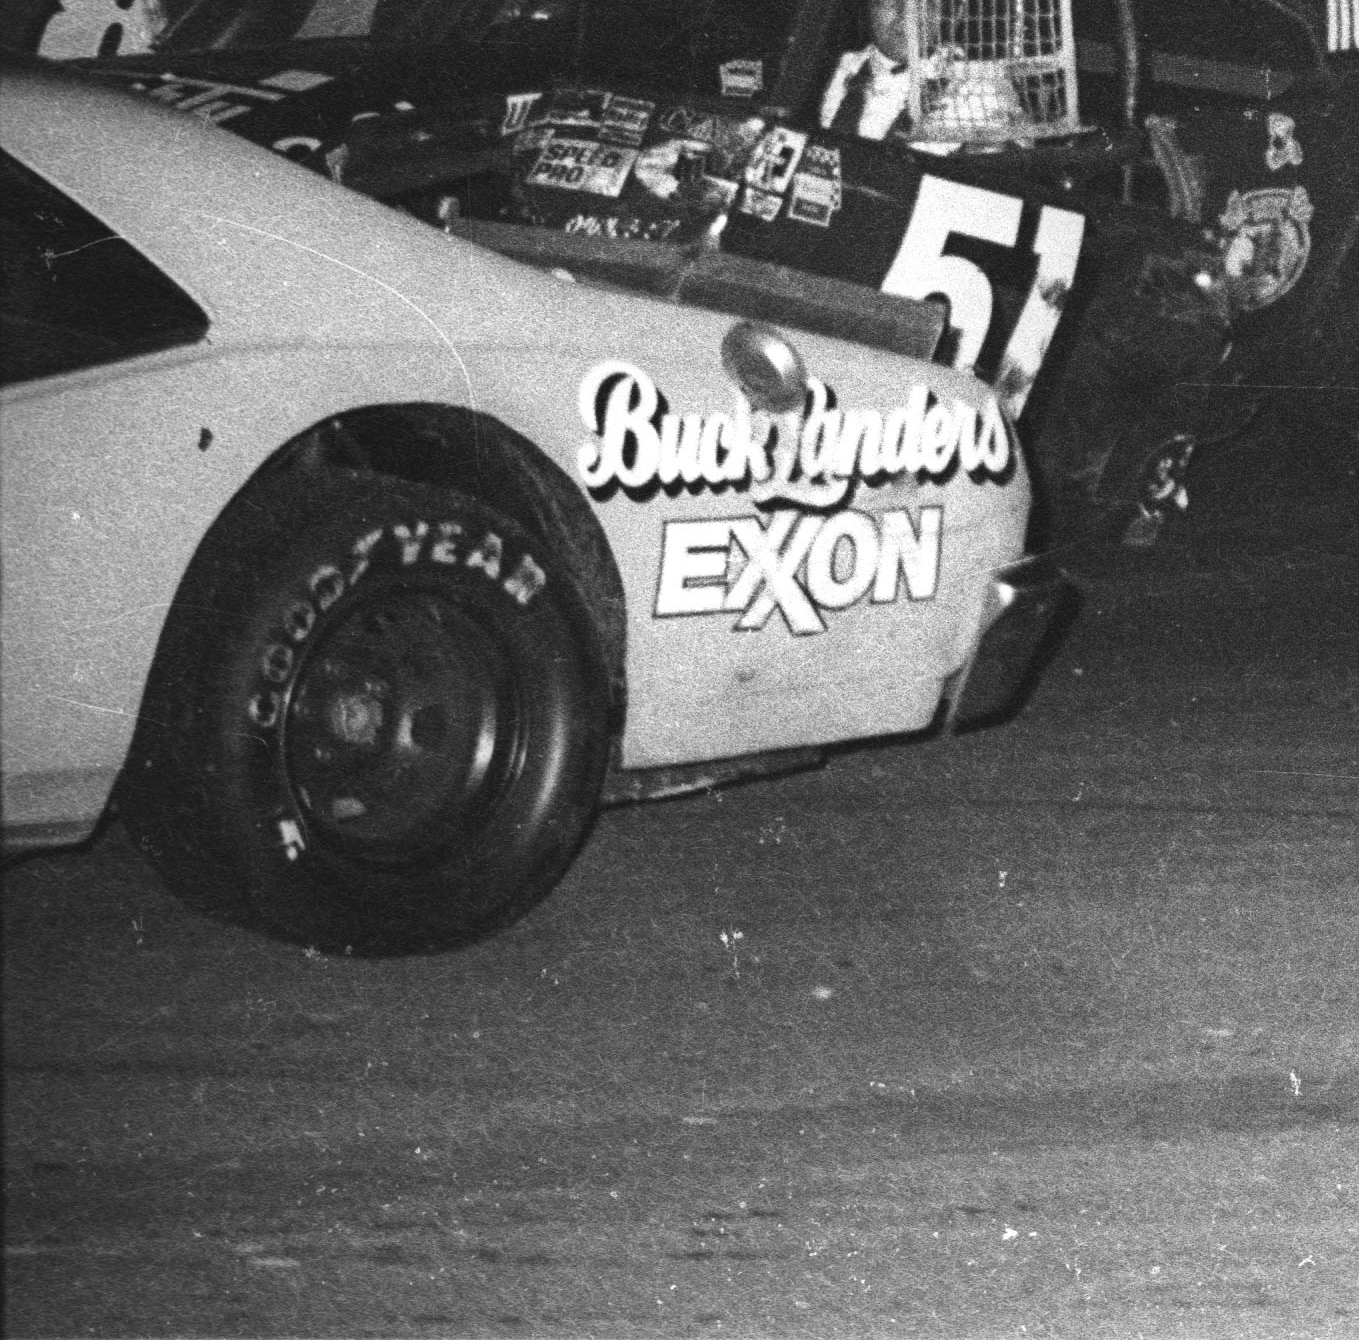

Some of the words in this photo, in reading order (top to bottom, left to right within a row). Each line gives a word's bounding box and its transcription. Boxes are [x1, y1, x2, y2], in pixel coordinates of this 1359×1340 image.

[532, 160, 586, 184] PRO
[543, 141, 622, 170] SPEED
[880, 173, 1085, 421] 51
[576, 359, 778, 503] Buck
[247, 520, 547, 728] GOODYEAR
[652, 504, 944, 637] EXXON
